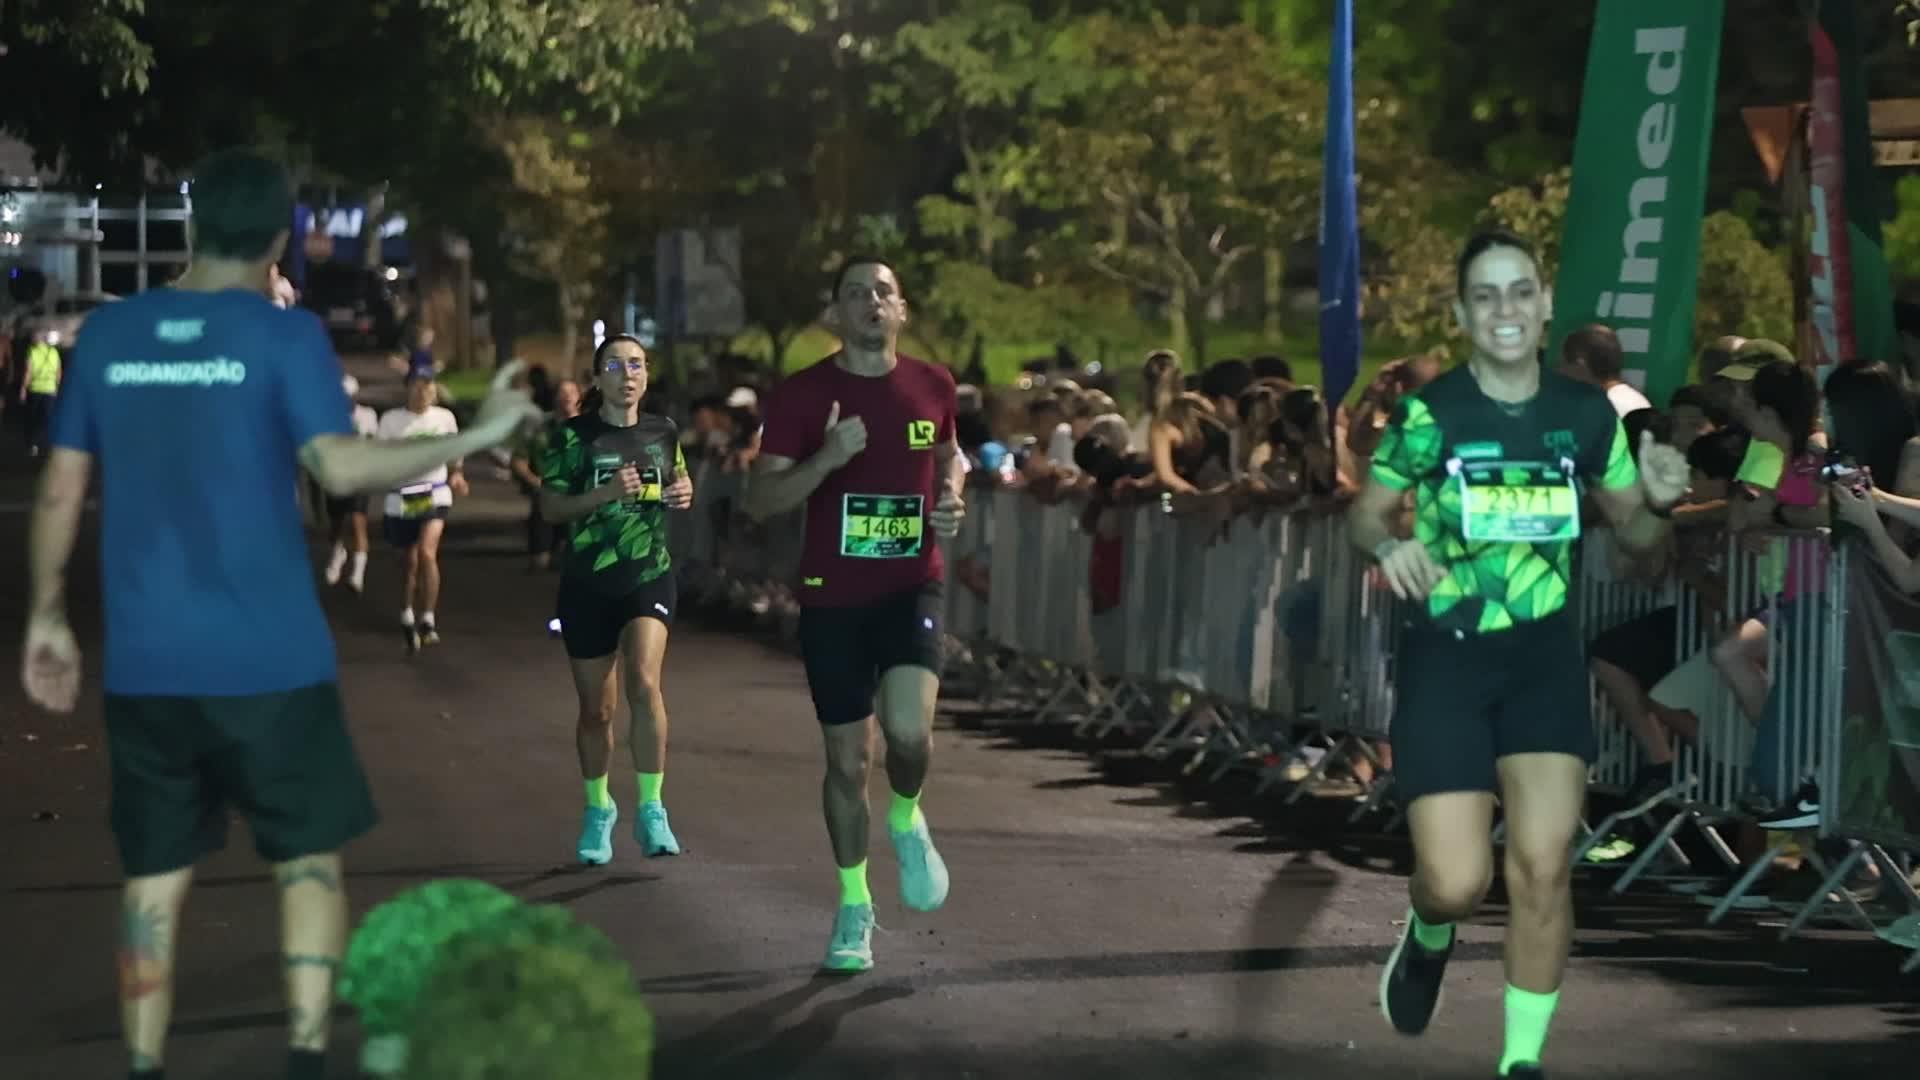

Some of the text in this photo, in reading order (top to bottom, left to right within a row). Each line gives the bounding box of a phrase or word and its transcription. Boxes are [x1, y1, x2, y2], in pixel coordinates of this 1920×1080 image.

[1596, 26, 1688, 393] nimed
[108, 356, 246, 386] ORGANIZAÇÃO
[1487, 487, 1552, 512] 2371
[862, 516, 910, 538] 1463
